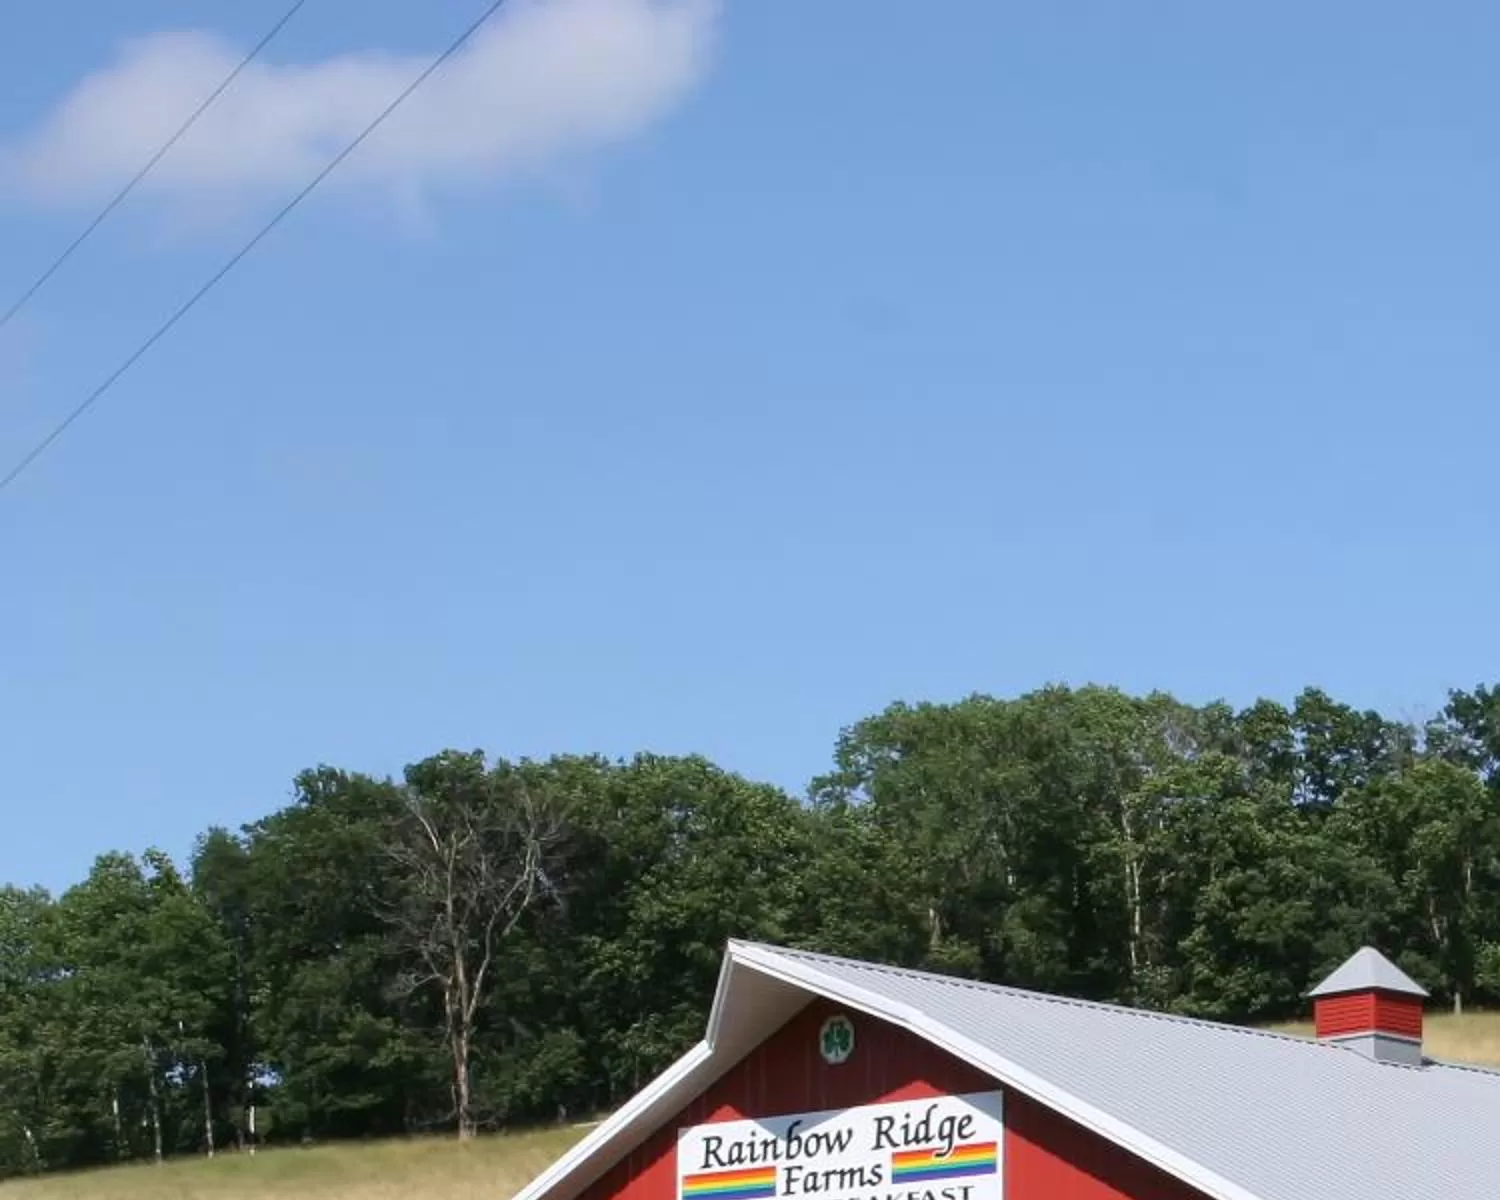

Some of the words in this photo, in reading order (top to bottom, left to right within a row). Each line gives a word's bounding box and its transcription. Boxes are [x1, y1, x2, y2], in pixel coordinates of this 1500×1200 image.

[701, 1120, 853, 1168] Rainbow
[873, 1104, 976, 1157] Ridge
[781, 1164, 883, 1196] Farms
